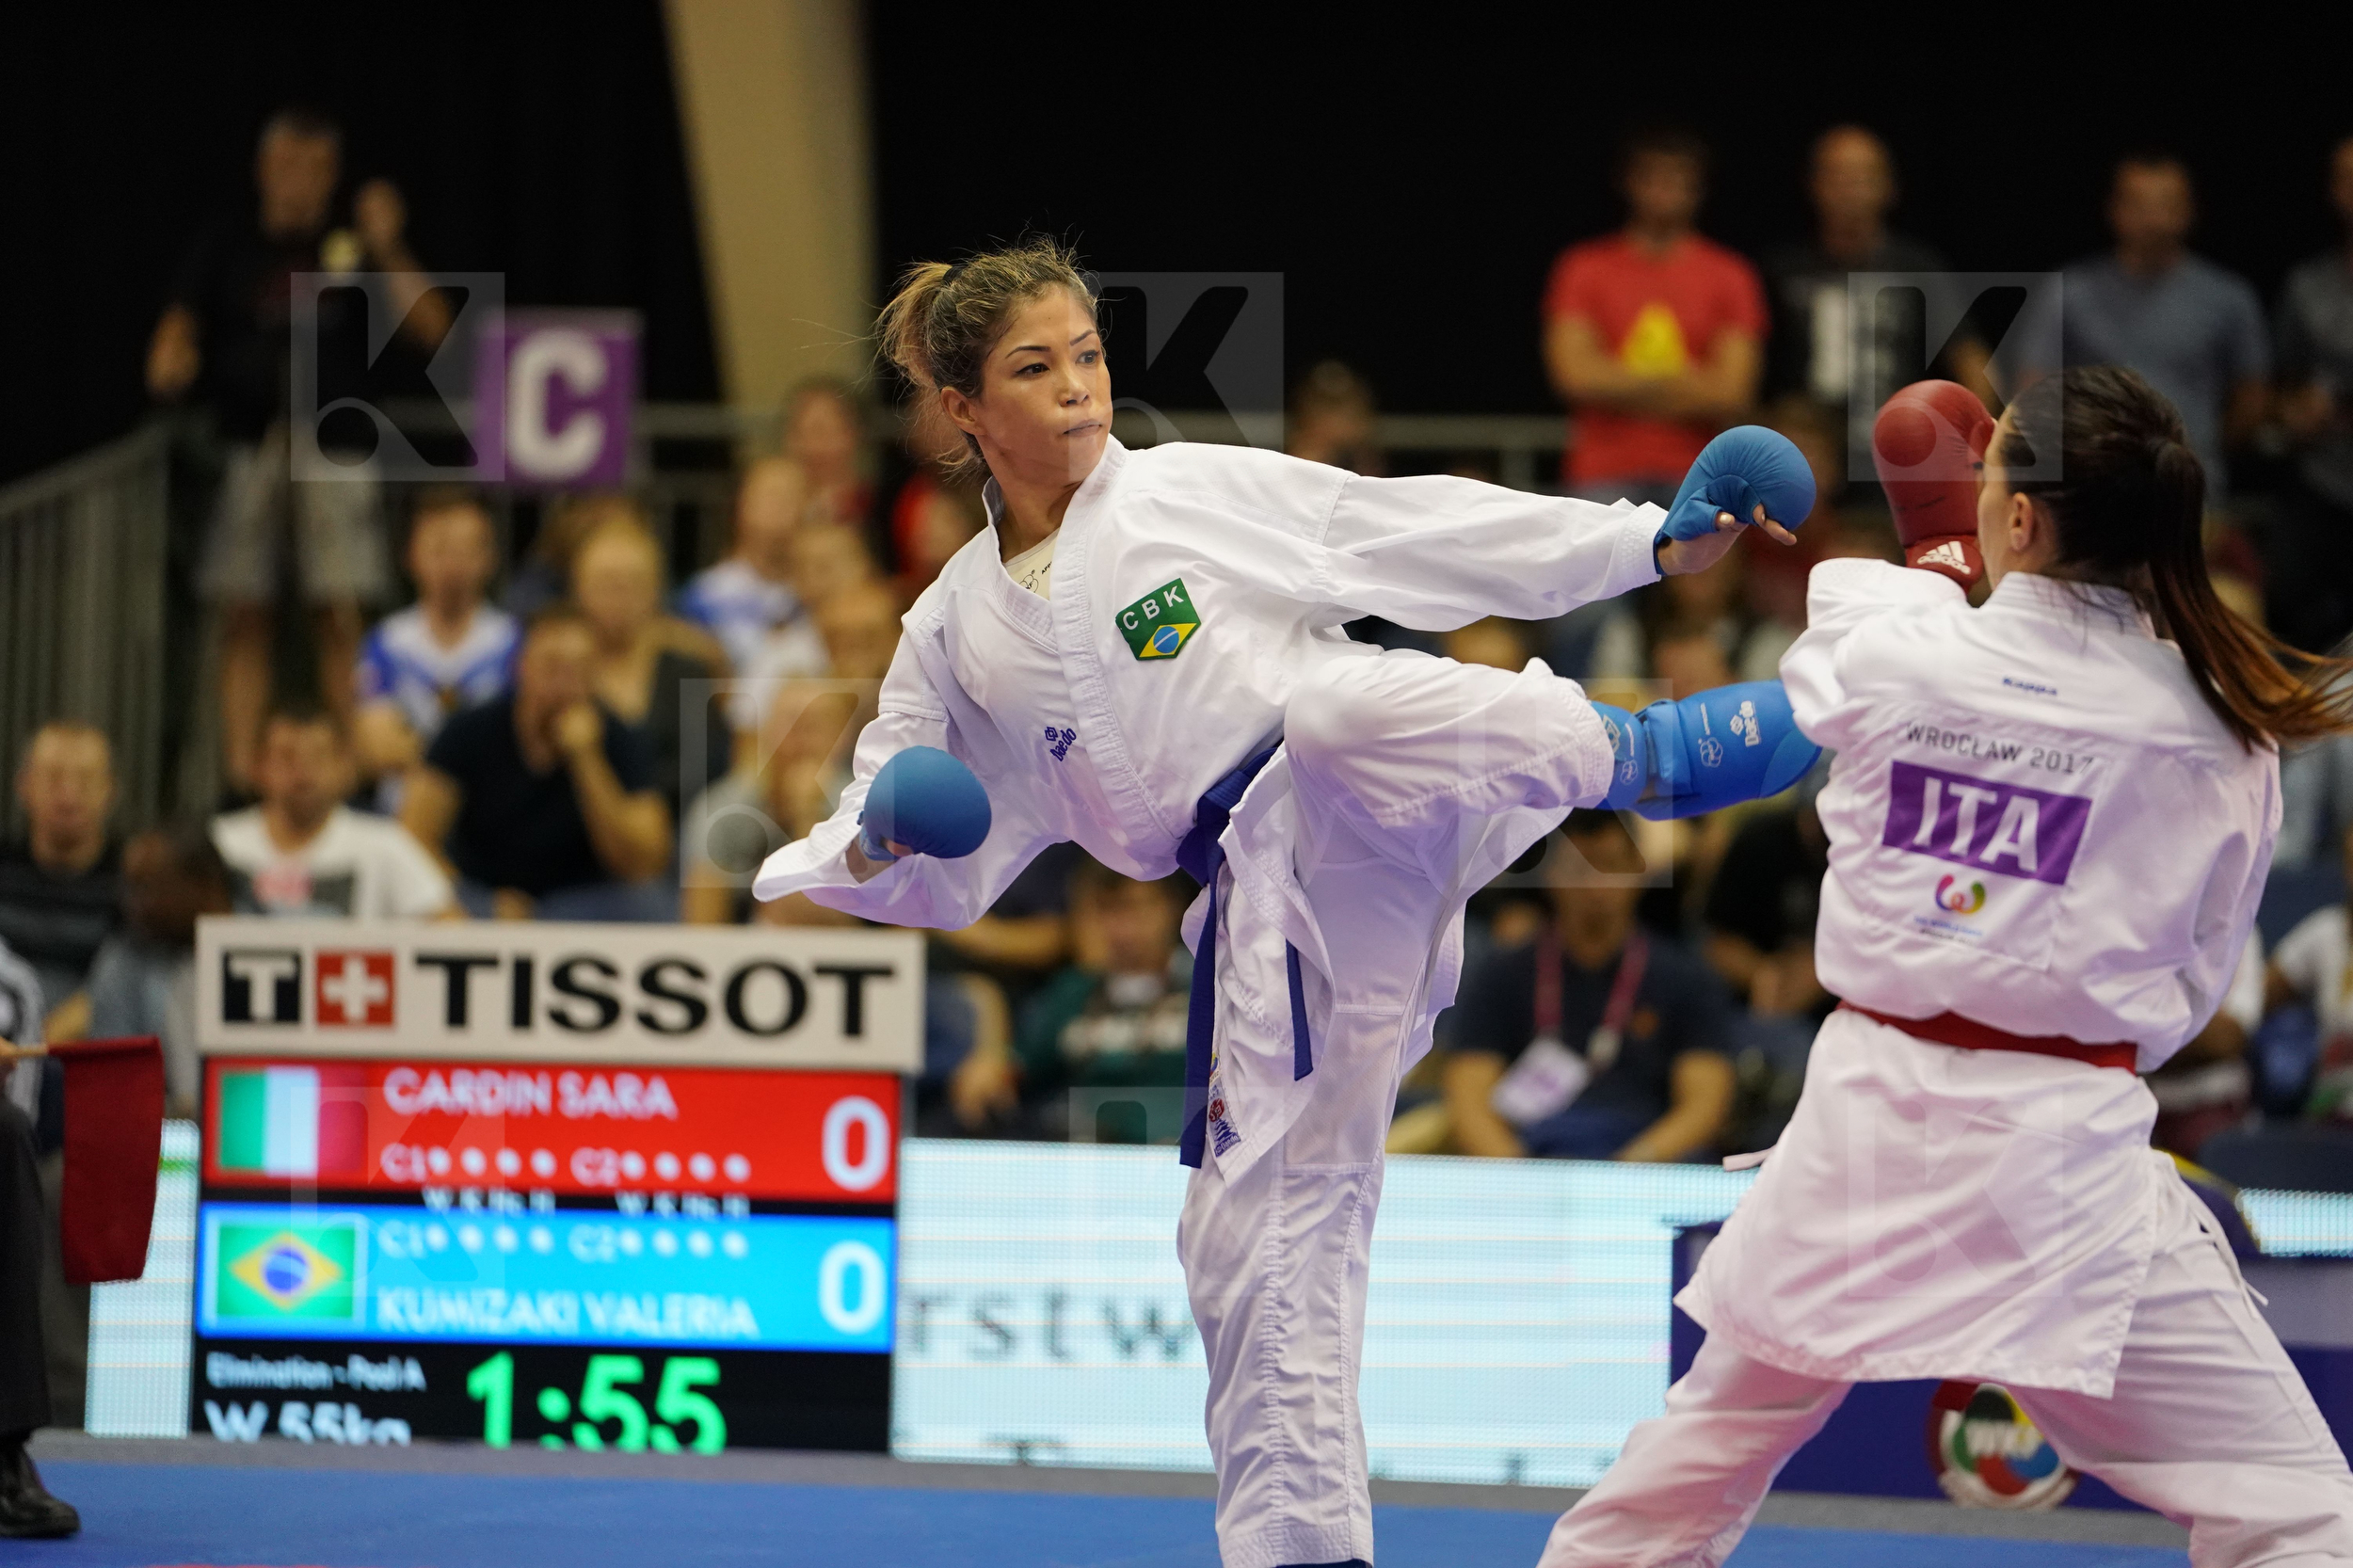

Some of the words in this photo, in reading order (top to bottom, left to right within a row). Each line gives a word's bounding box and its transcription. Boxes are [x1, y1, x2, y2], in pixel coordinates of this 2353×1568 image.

[506, 328, 607, 480] C
[1916, 553, 1971, 575] adidas
[1123, 585, 1184, 631] CBK
[1049, 728, 1077, 762] Daedo
[2028, 747, 2094, 775] 2017
[1913, 776, 2041, 872] ITA
[415, 952, 894, 1038] TISSOT
[383, 1066, 552, 1116] CARDIN
[558, 1070, 679, 1121] SARA
[822, 1096, 890, 1192] 0
[819, 1240, 887, 1335] 0
[584, 1289, 760, 1339] VALERIA
[206, 1352, 332, 1390] Elimination
[347, 1353, 402, 1391] Pool
[403, 1355, 426, 1391] A
[203, 1400, 269, 1444] W
[467, 1352, 727, 1454] 1:55
